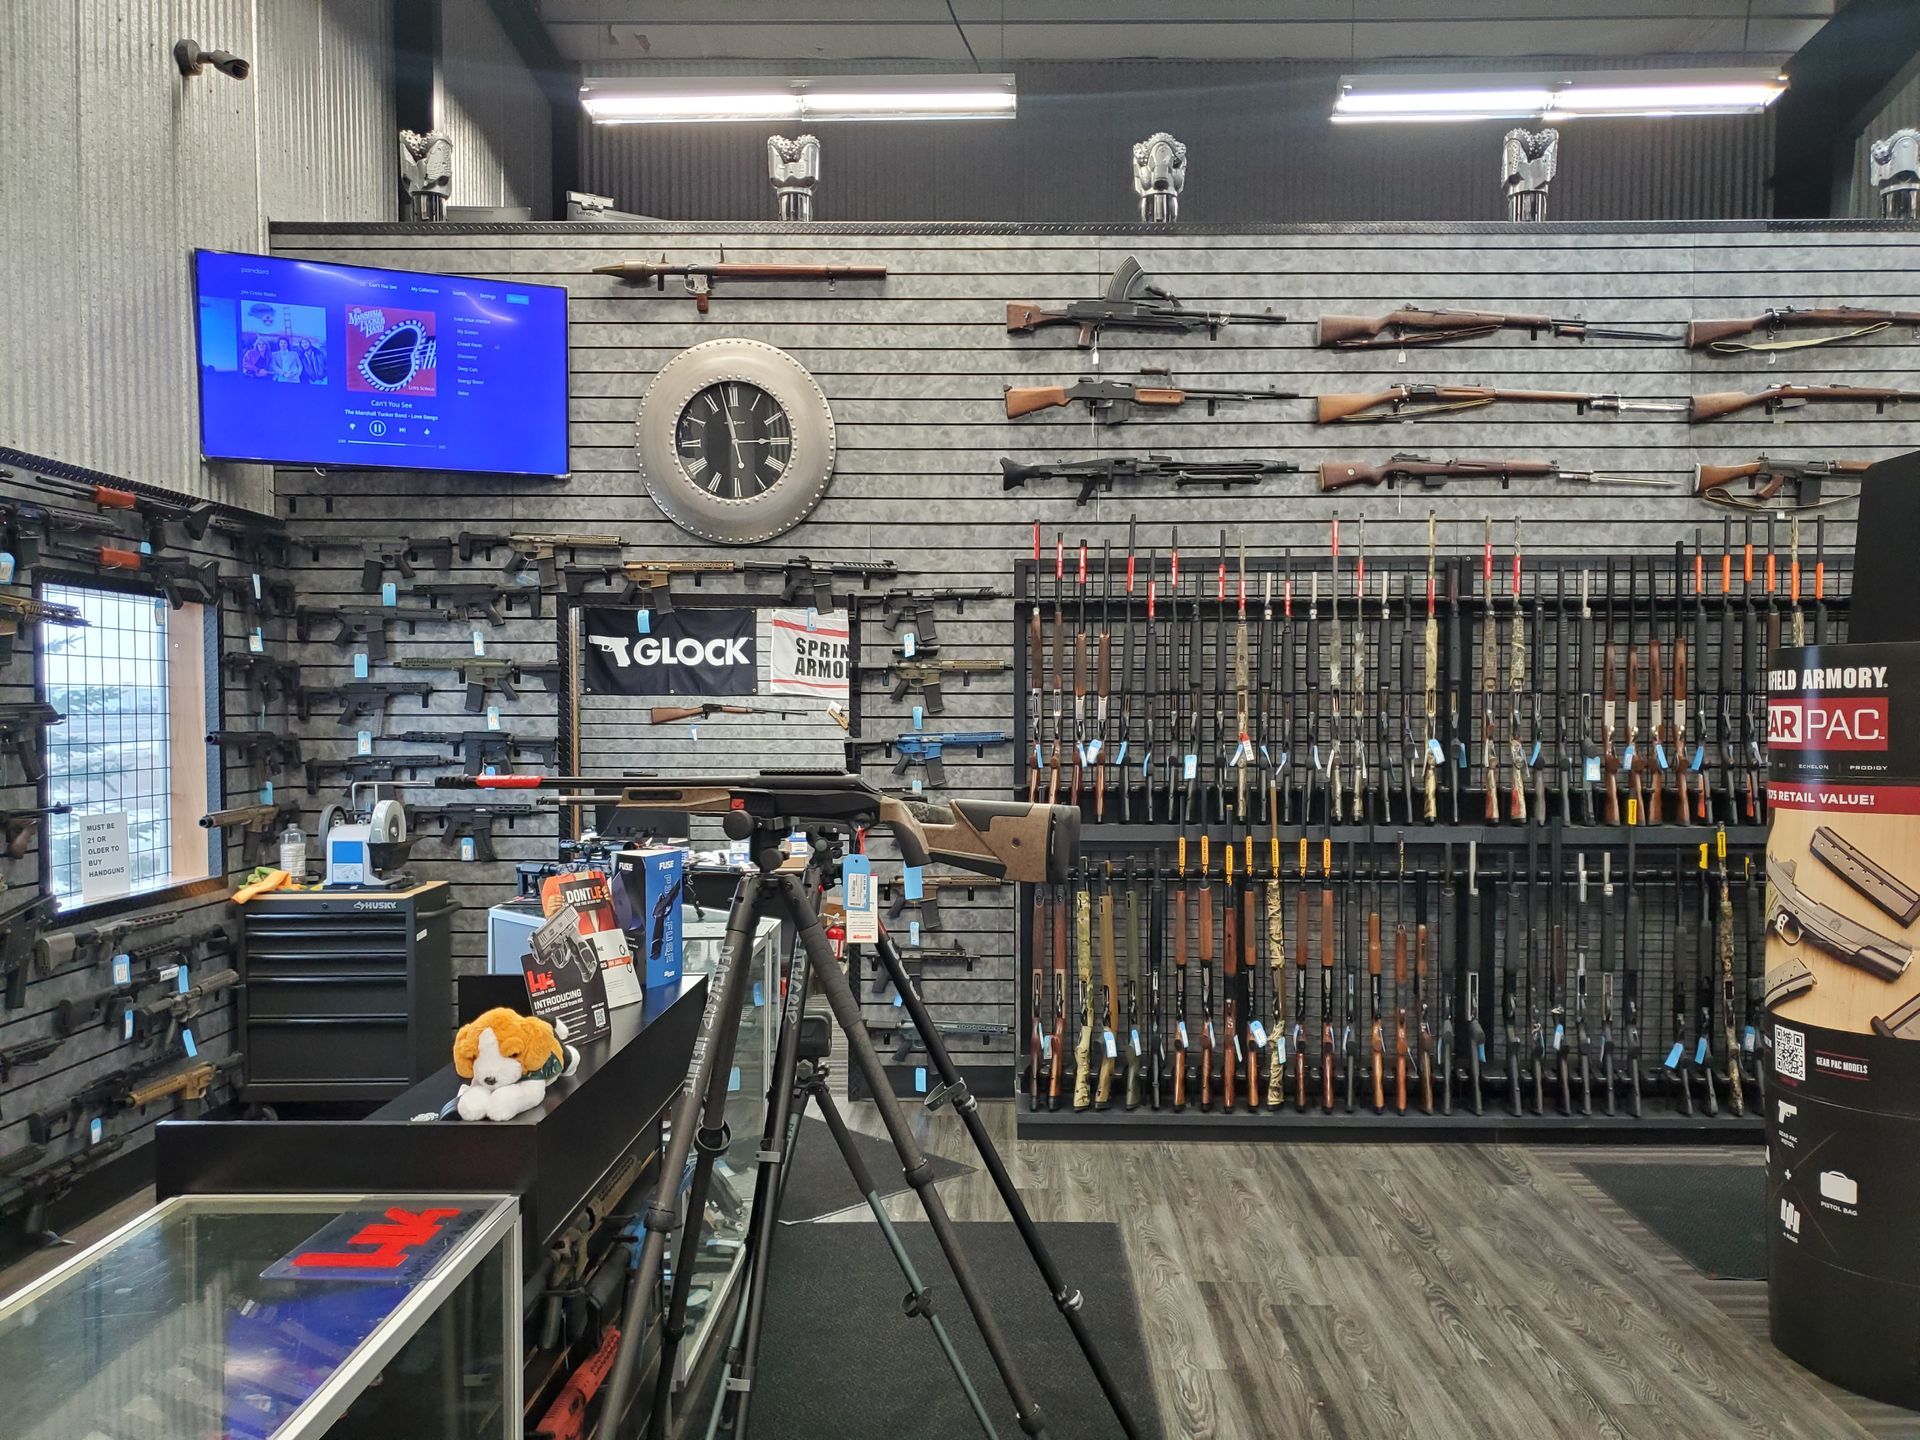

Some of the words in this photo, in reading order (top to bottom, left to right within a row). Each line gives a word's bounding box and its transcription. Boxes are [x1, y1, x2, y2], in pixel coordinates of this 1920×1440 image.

[633, 637, 750, 666] GLOCK
[795, 657, 849, 679] ARMO
[1768, 669, 1797, 690] FIELD
[1807, 709, 1879, 740] PAC
[1778, 791, 1815, 802] RETAIL
[1819, 793, 1875, 806] VALUE!
[87, 823, 105, 831] MUST
[88, 846, 110, 855] OLDER
[89, 867, 125, 878] HANDGUNS
[619, 862, 633, 872] FUSE
[659, 860, 674, 870] FUSE
[786, 930, 807, 1025] ATHGRIP
[702, 945, 735, 1030] DEATHGRIP
[533, 988, 582, 1010] INTRODUCING
[1815, 1056, 1830, 1067] GEAR
[1830, 1060, 1842, 1069] PAC
[1843, 1062, 1868, 1074] MODELS
[1820, 1201, 1842, 1212] PISTOL
[1843, 1208, 1858, 1216] BAG
